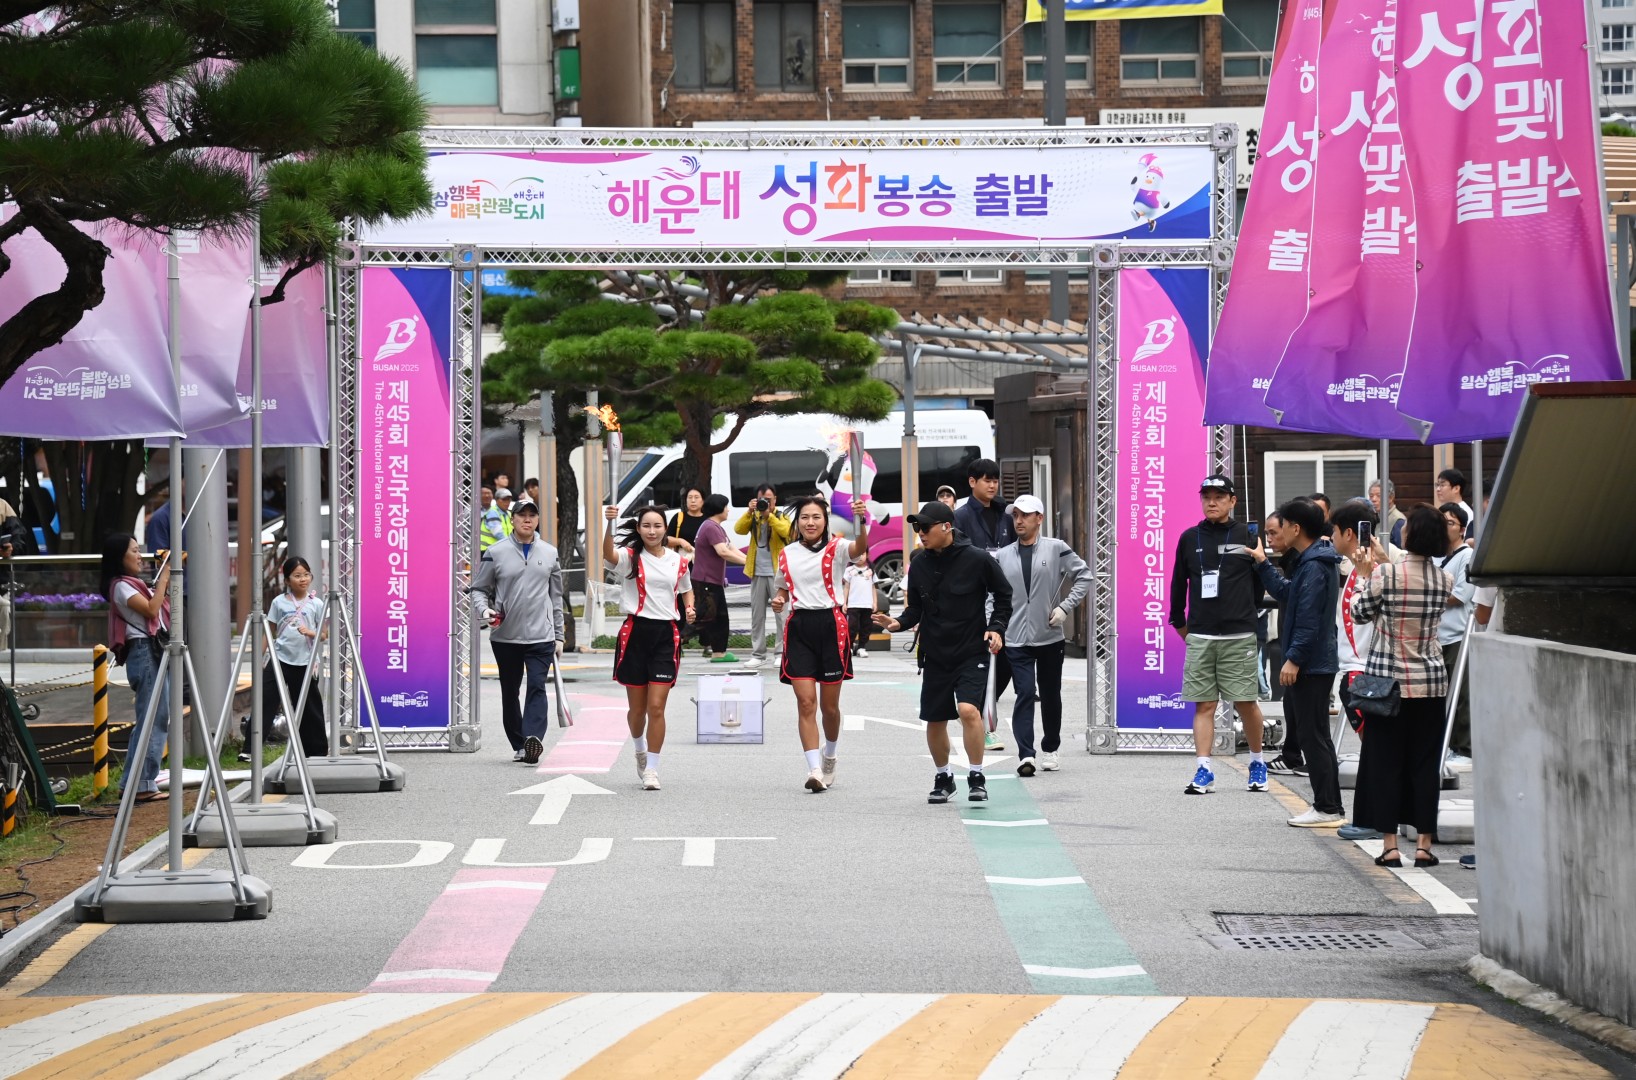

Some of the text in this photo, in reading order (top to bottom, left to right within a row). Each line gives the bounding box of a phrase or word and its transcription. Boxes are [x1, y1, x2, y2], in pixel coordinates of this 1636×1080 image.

[564, 85, 577, 95] 4F
[513, 188, 545, 201] 해운대
[606, 157, 1054, 236] 해운대 성화봉송 출발
[373, 363, 420, 372] BUSAN 2025
[374, 381, 384, 539] The 45th National Para Games
[1130, 381, 1142, 540] The 45th National Para Games
[386, 380, 410, 673] 제45회 전국장애인체육대회
[1142, 381, 1167, 675] 제45회 전국장애인체육대회
[291, 837, 777, 869] OUT
